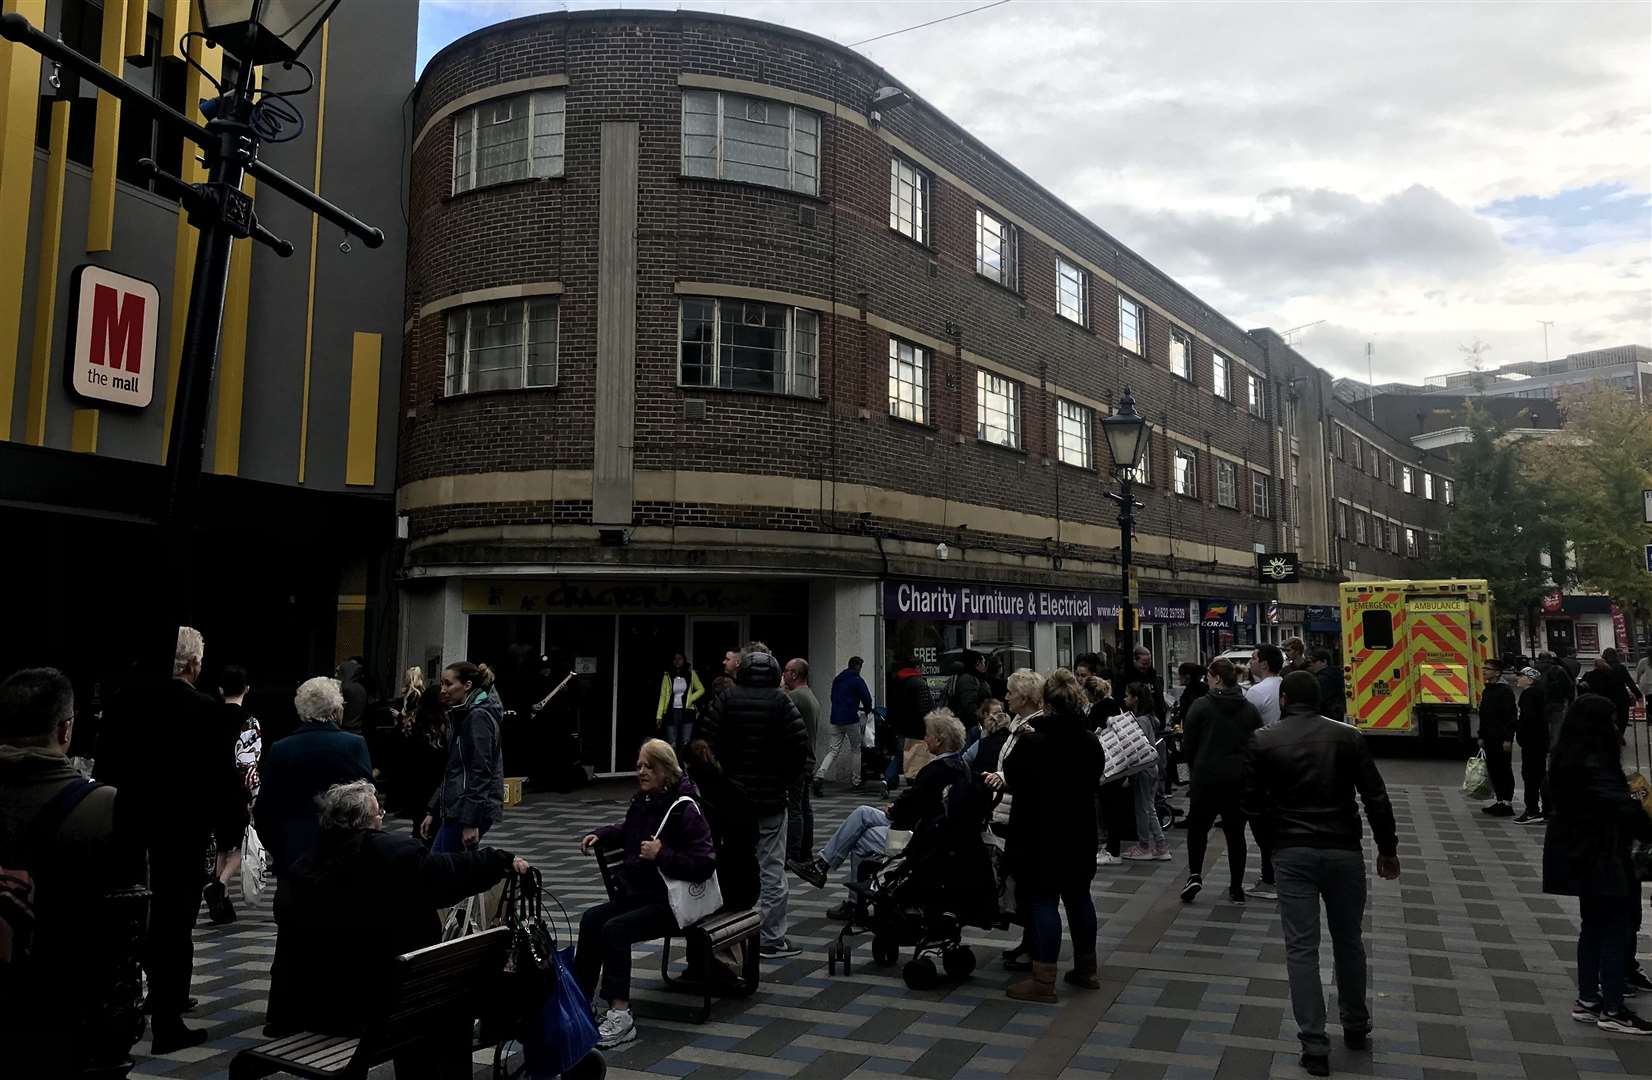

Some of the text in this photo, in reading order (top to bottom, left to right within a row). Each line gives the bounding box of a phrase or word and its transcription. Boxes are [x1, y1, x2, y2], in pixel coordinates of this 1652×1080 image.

[90, 284, 145, 374] M
[88, 368, 139, 393] the mall
[897, 584, 957, 619] Charity
[961, 588, 1024, 616] Furniture
[1027, 592, 1037, 616] &
[1040, 592, 1092, 617] Electrical
[1354, 601, 1399, 610] EMERGENCY
[1414, 601, 1460, 610] AMBULANCE
[1200, 620, 1231, 628] CORAL
[913, 647, 937, 663] FREE
